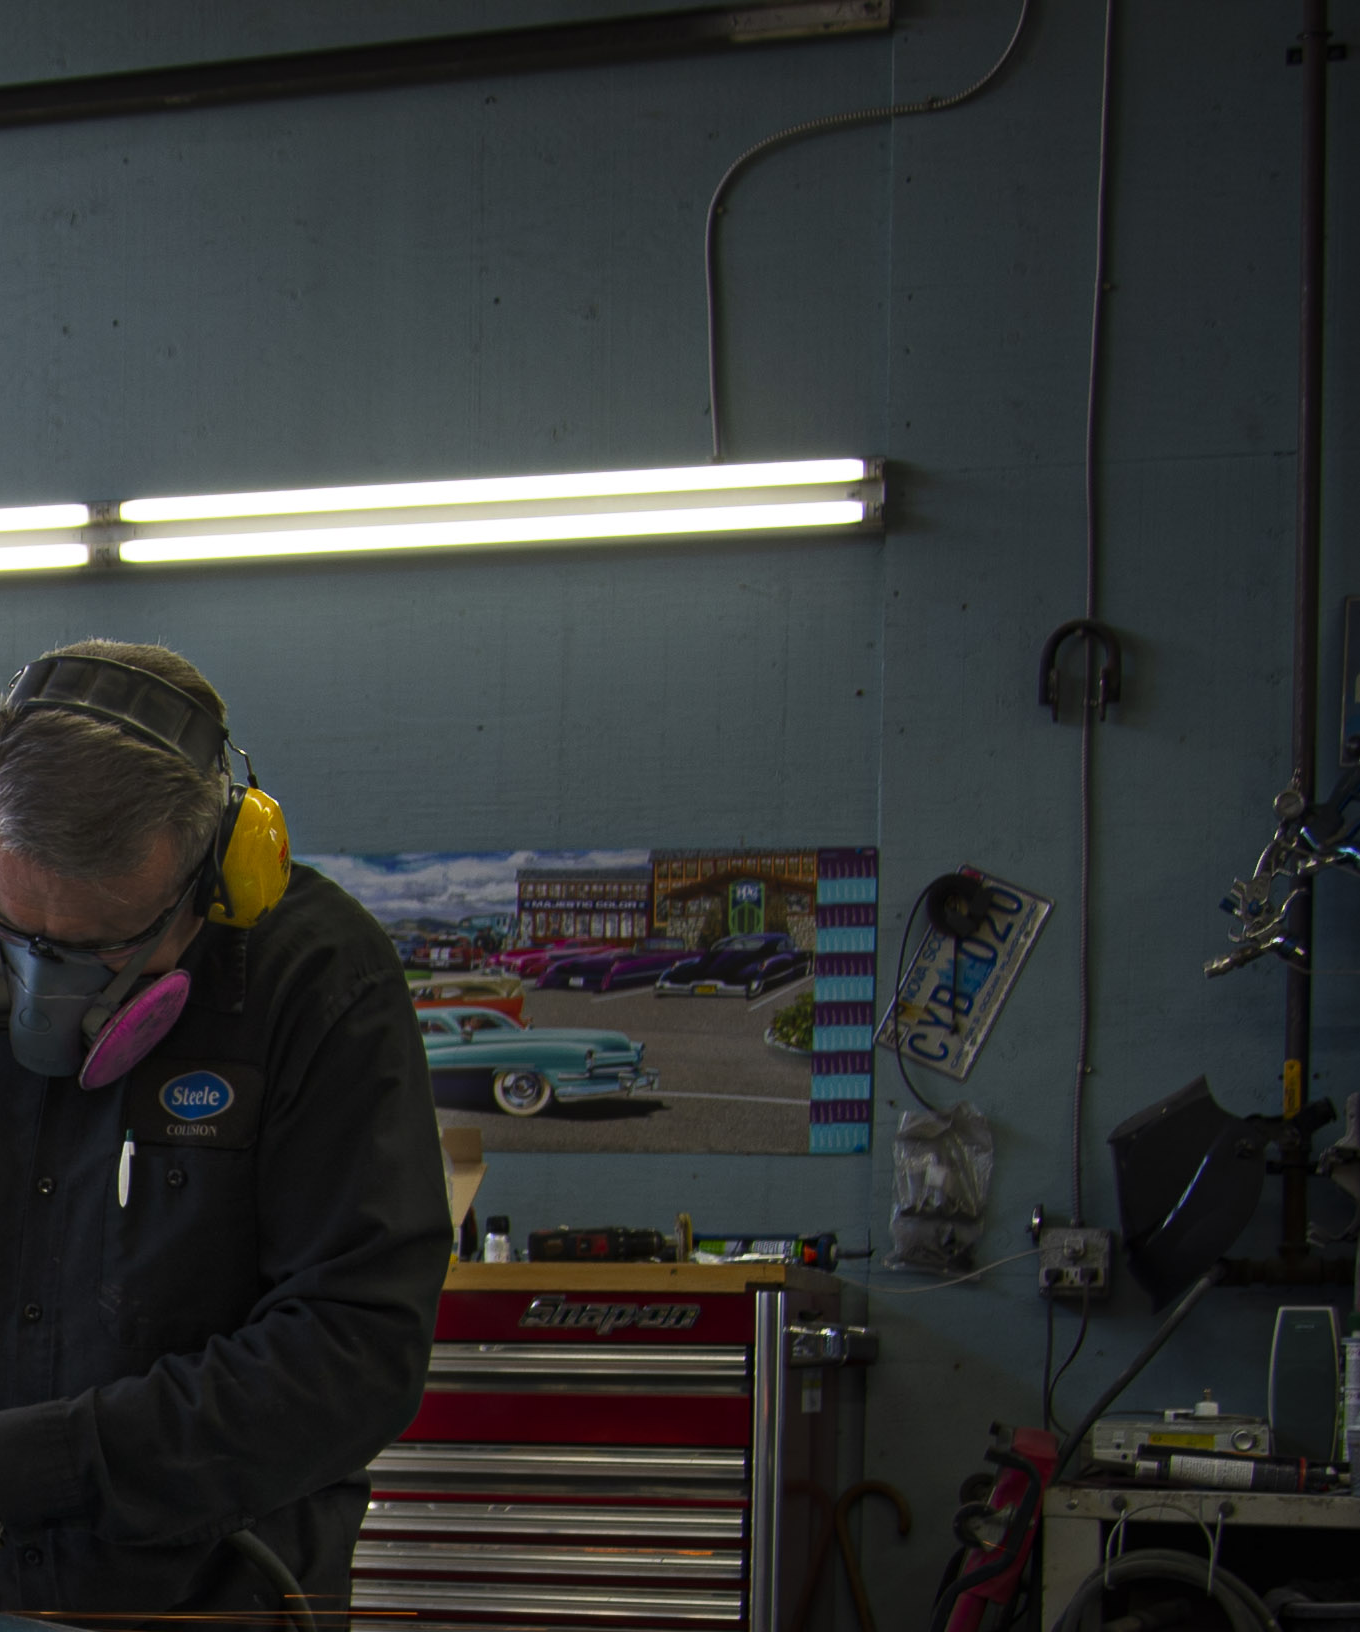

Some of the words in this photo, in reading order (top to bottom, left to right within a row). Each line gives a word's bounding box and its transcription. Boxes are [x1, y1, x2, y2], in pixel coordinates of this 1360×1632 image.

[531, 900, 593, 909] MAJESTIC
[595, 900, 637, 909] COLOR
[903, 965, 929, 1003] NOVA
[907, 983, 974, 1062] CYB
[172, 1086, 220, 1106] Steele
[166, 1124, 217, 1136] COLLISION
[519, 1295, 701, 1335] Snap-on
